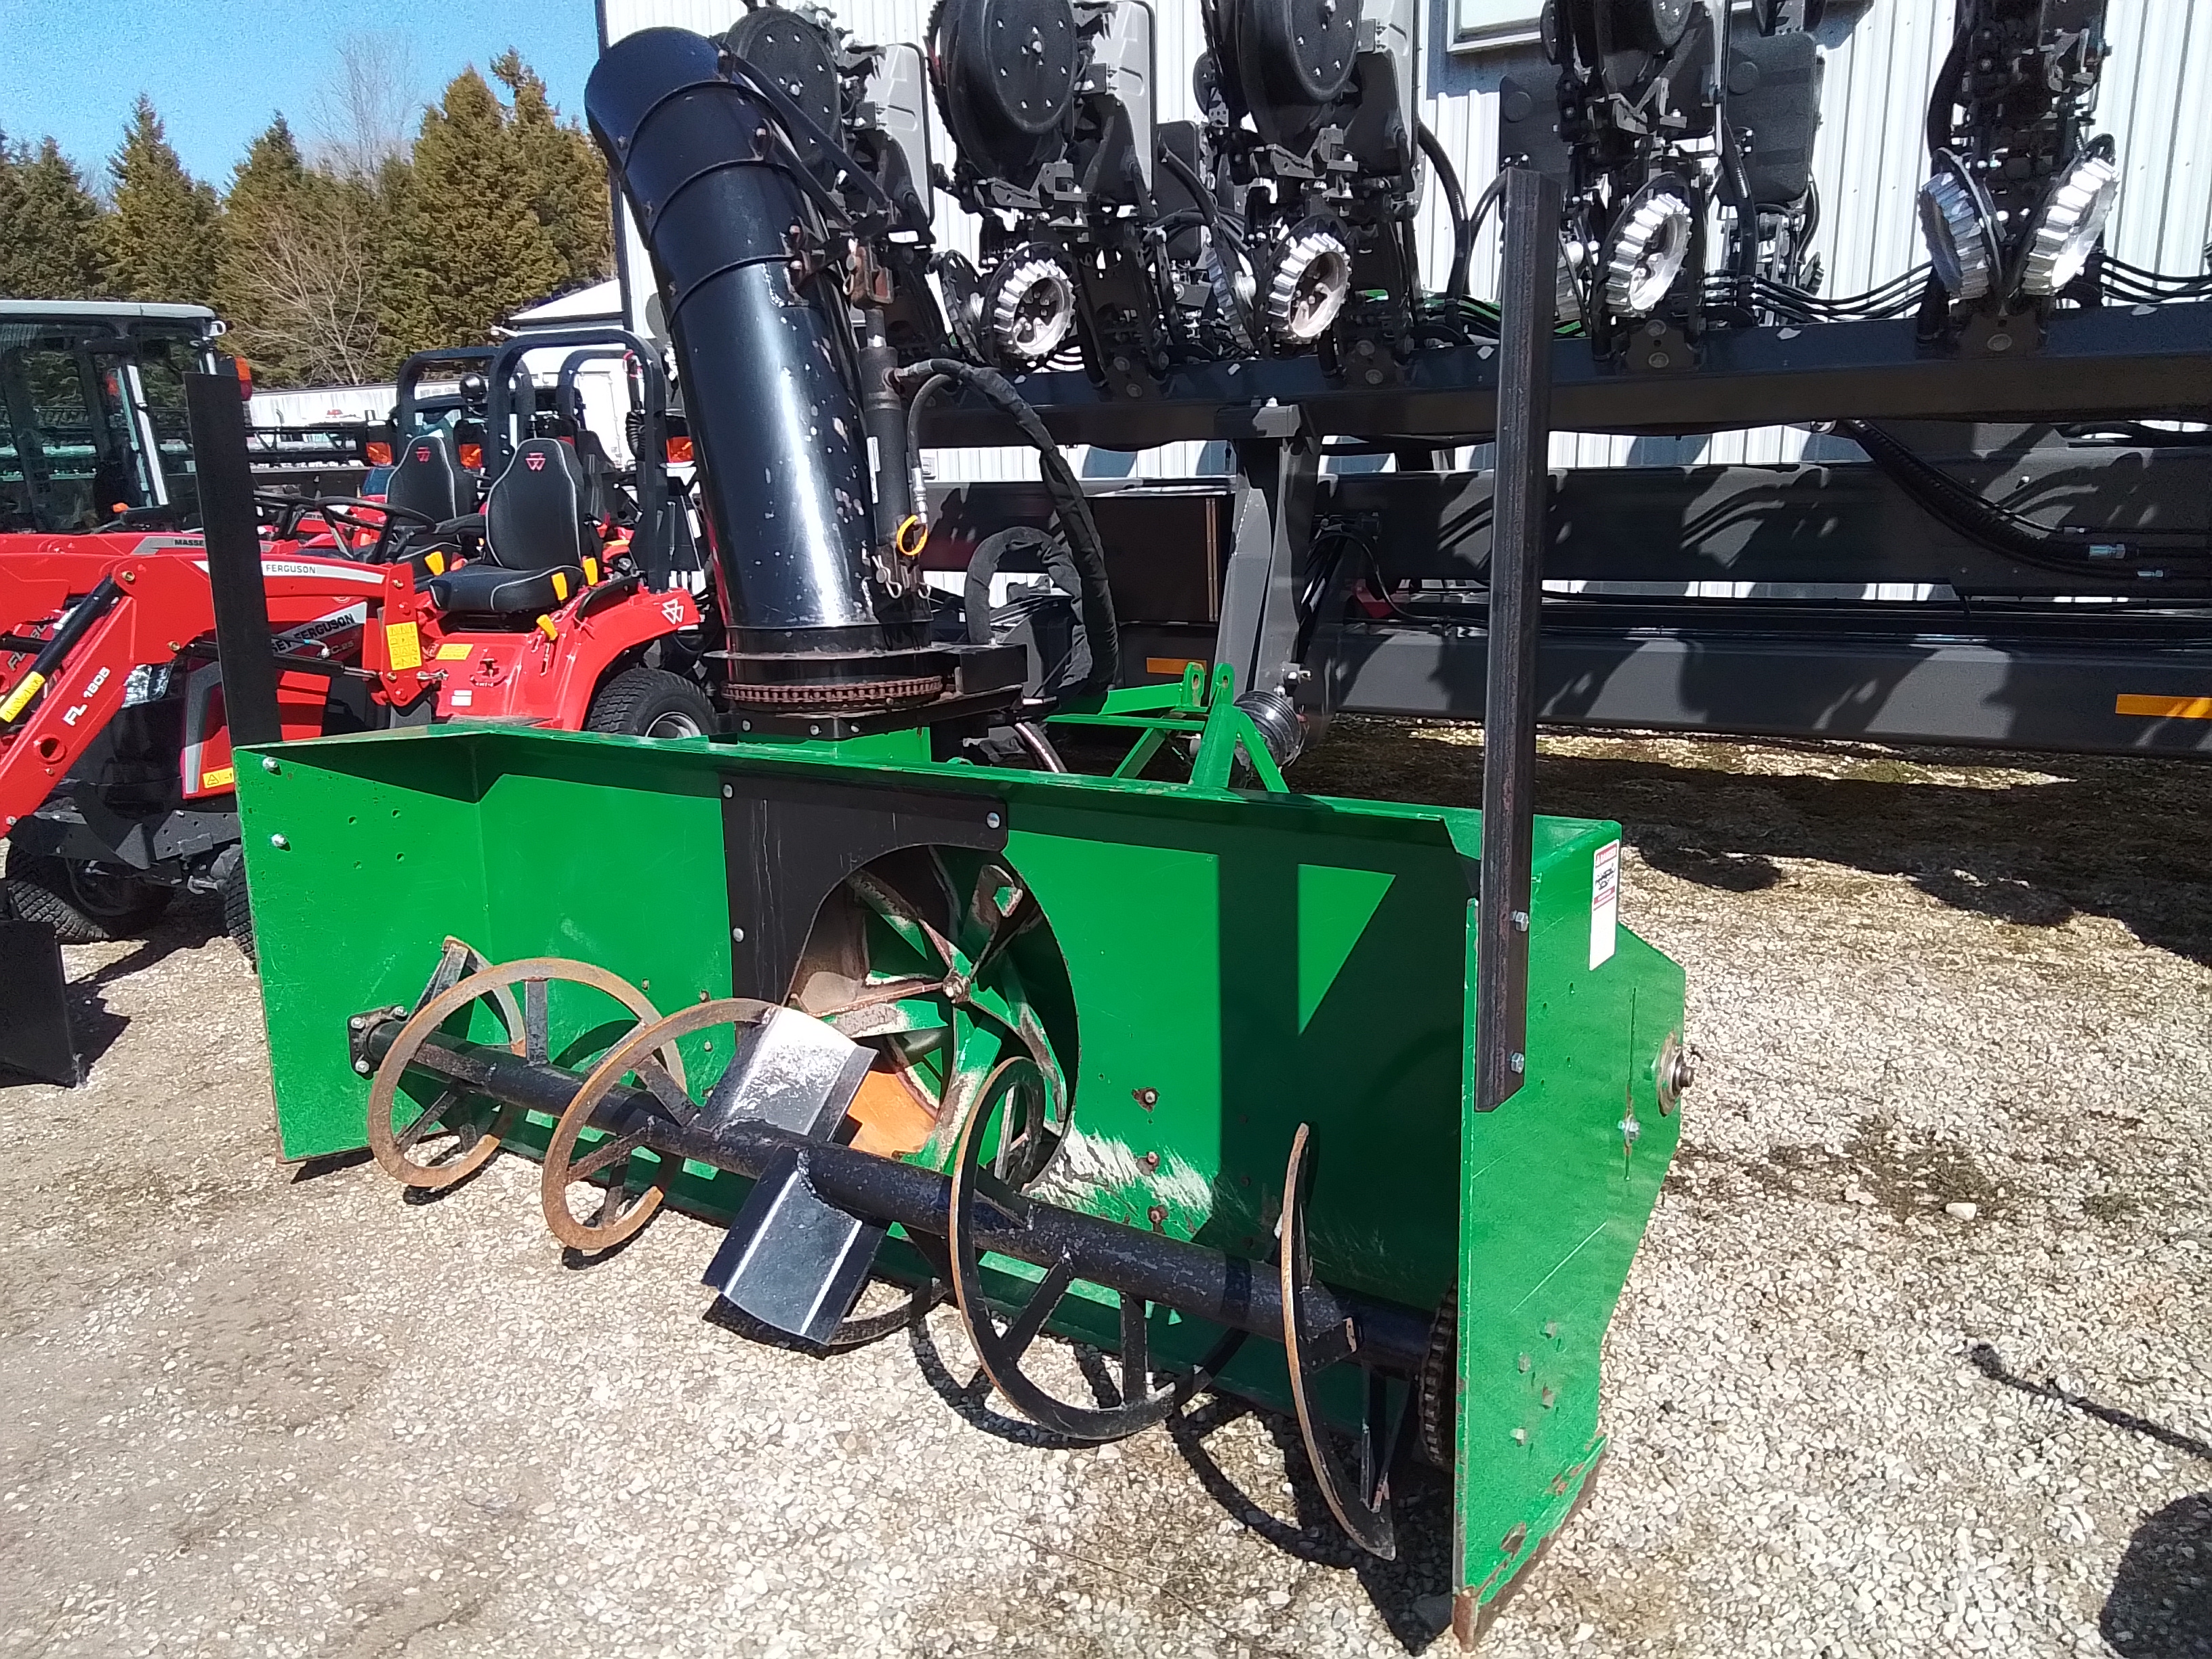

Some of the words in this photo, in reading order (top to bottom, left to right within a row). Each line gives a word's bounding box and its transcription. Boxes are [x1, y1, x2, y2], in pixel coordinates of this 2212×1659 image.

[266, 564, 316, 574] FERGUSON
[293, 613, 355, 640] FERGUSON
[63, 704, 88, 726] FL
